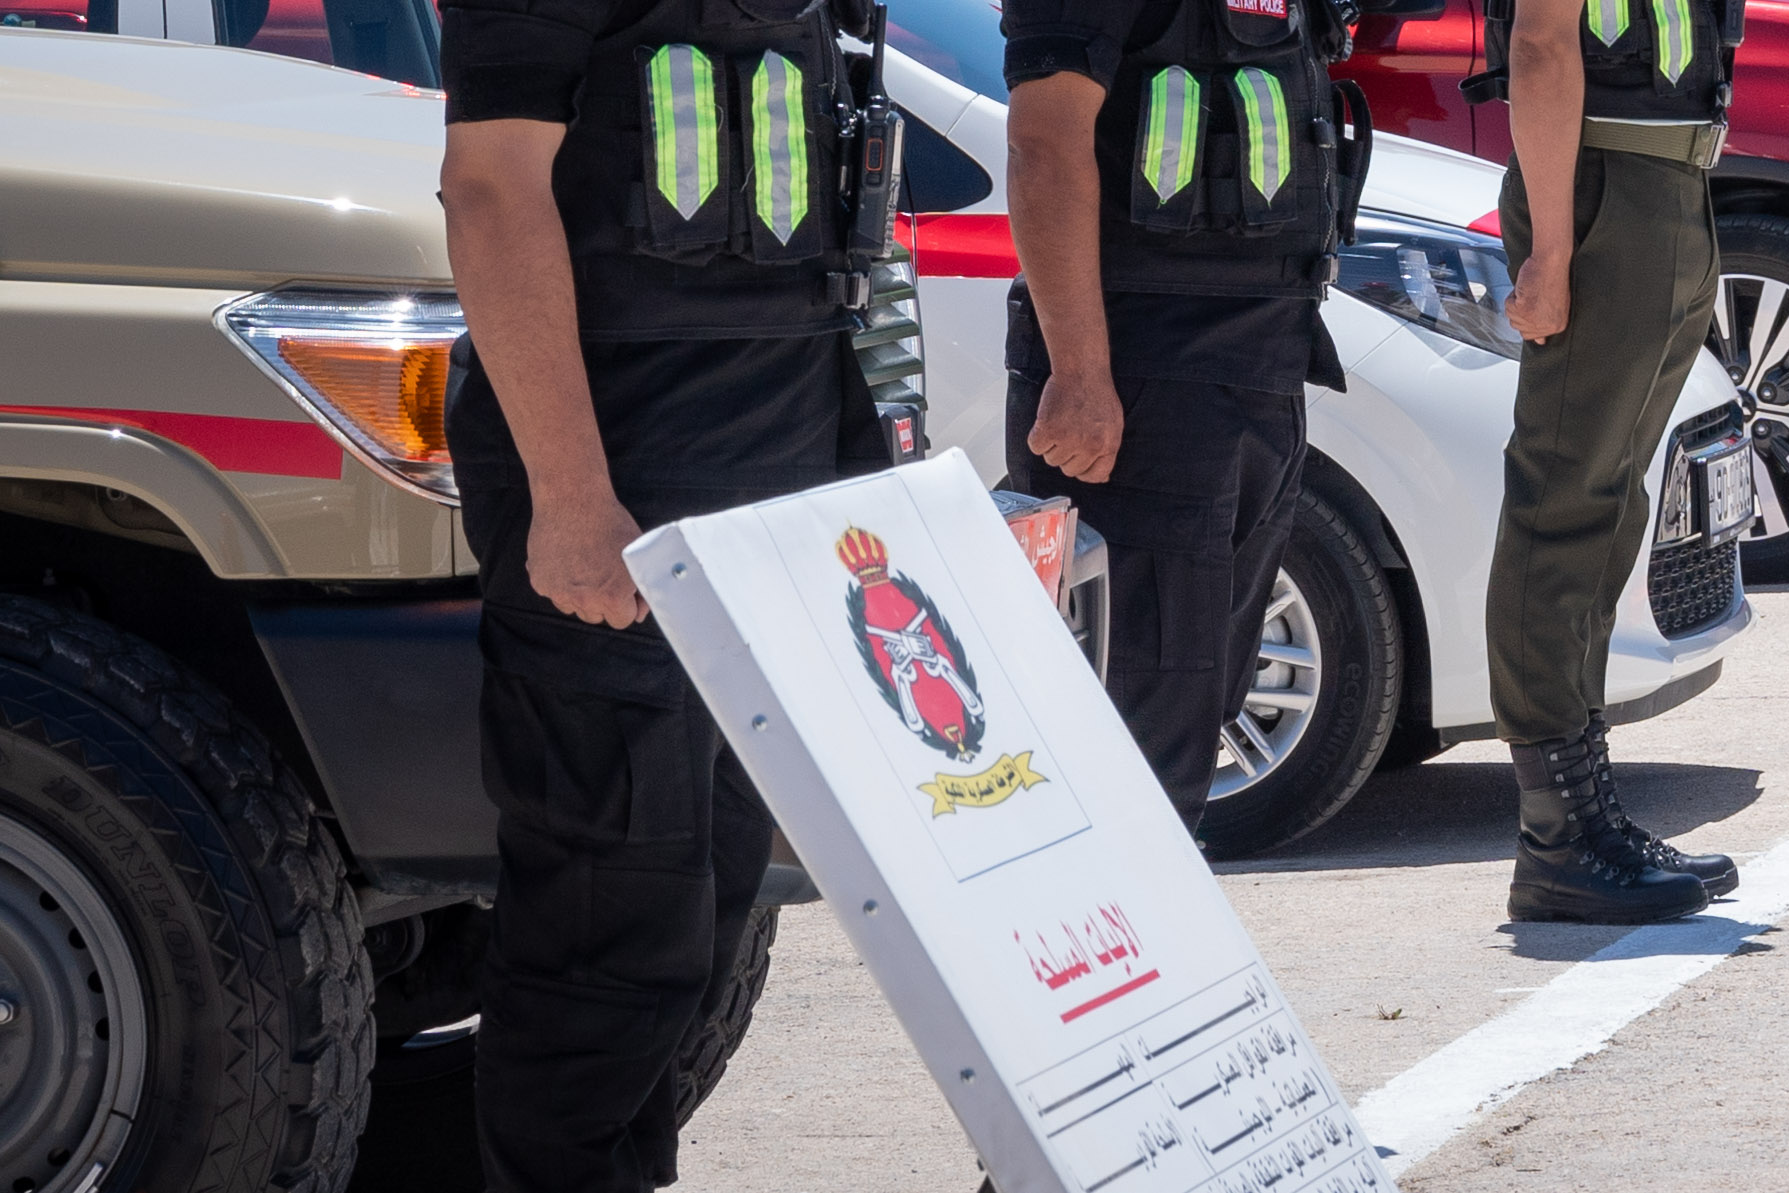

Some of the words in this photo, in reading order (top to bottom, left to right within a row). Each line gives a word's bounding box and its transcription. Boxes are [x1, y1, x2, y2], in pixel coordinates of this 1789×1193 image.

[41, 774, 207, 1010] DUNLOP
[1013, 914, 1092, 990] المسلحة
[1137, 973, 1268, 1060] الواجبات
